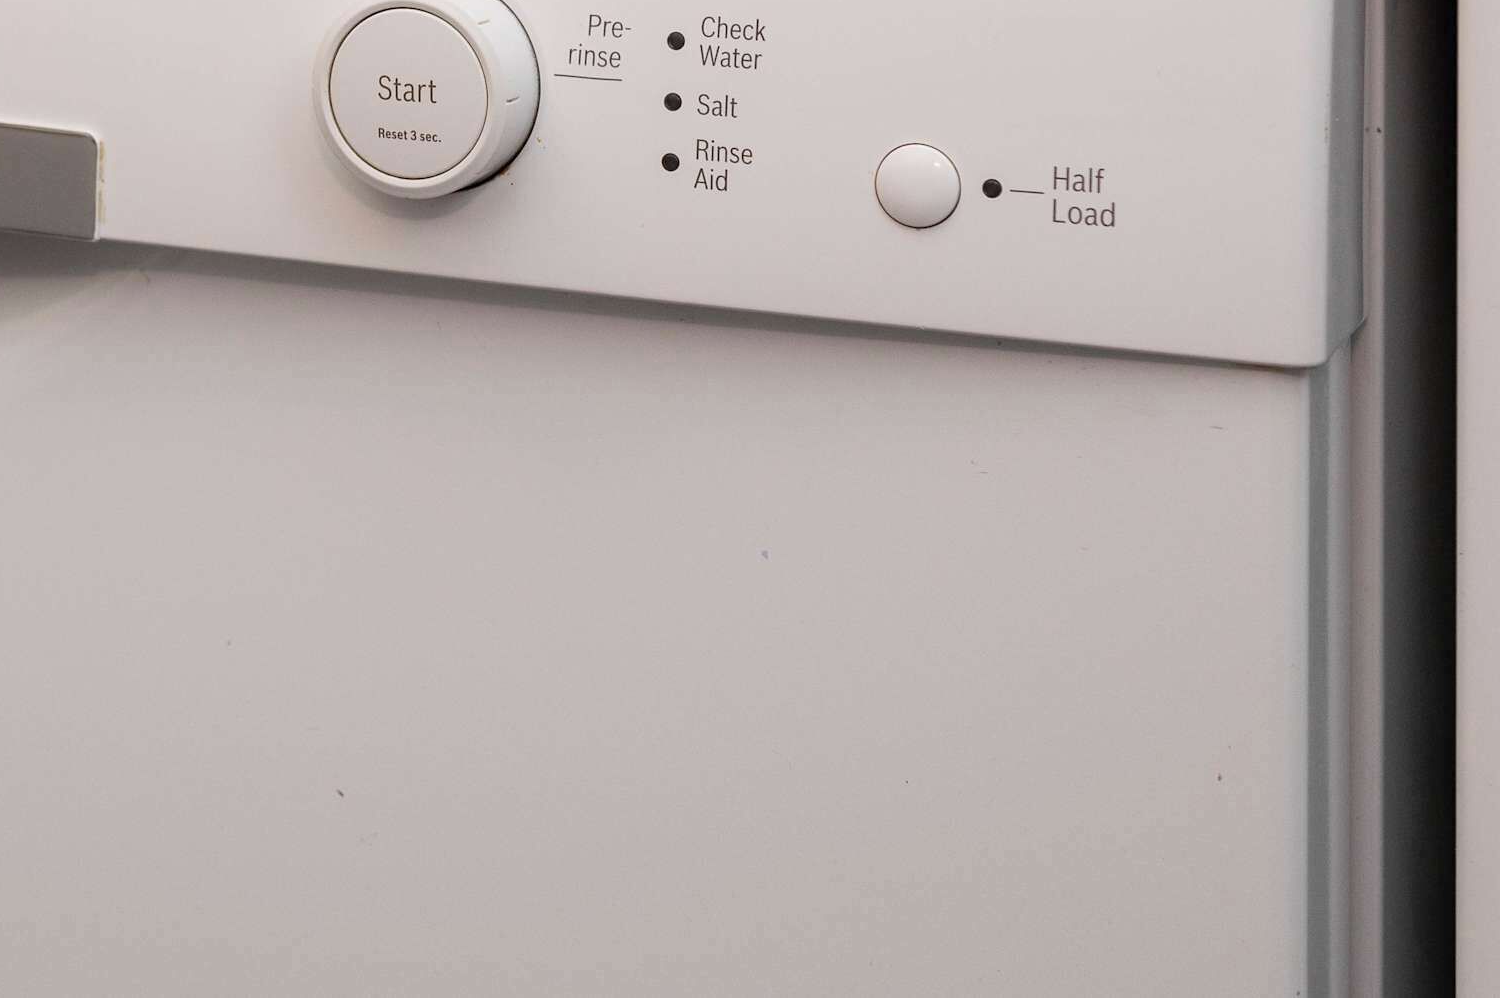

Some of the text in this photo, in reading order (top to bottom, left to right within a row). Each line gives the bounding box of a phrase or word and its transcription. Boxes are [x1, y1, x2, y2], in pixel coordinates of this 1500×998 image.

[587, 14, 633, 38] Pre-
[700, 16, 767, 42] Check
[568, 43, 622, 68] rinse
[699, 44, 764, 70] Water
[377, 75, 438, 104] Start
[696, 94, 739, 118] Salt
[377, 127, 442, 142] Reset 3 sec.
[695, 139, 754, 165] Rinse
[693, 168, 729, 192] Aid
[1052, 166, 1106, 194] Half
[1051, 199, 1116, 227] Load
